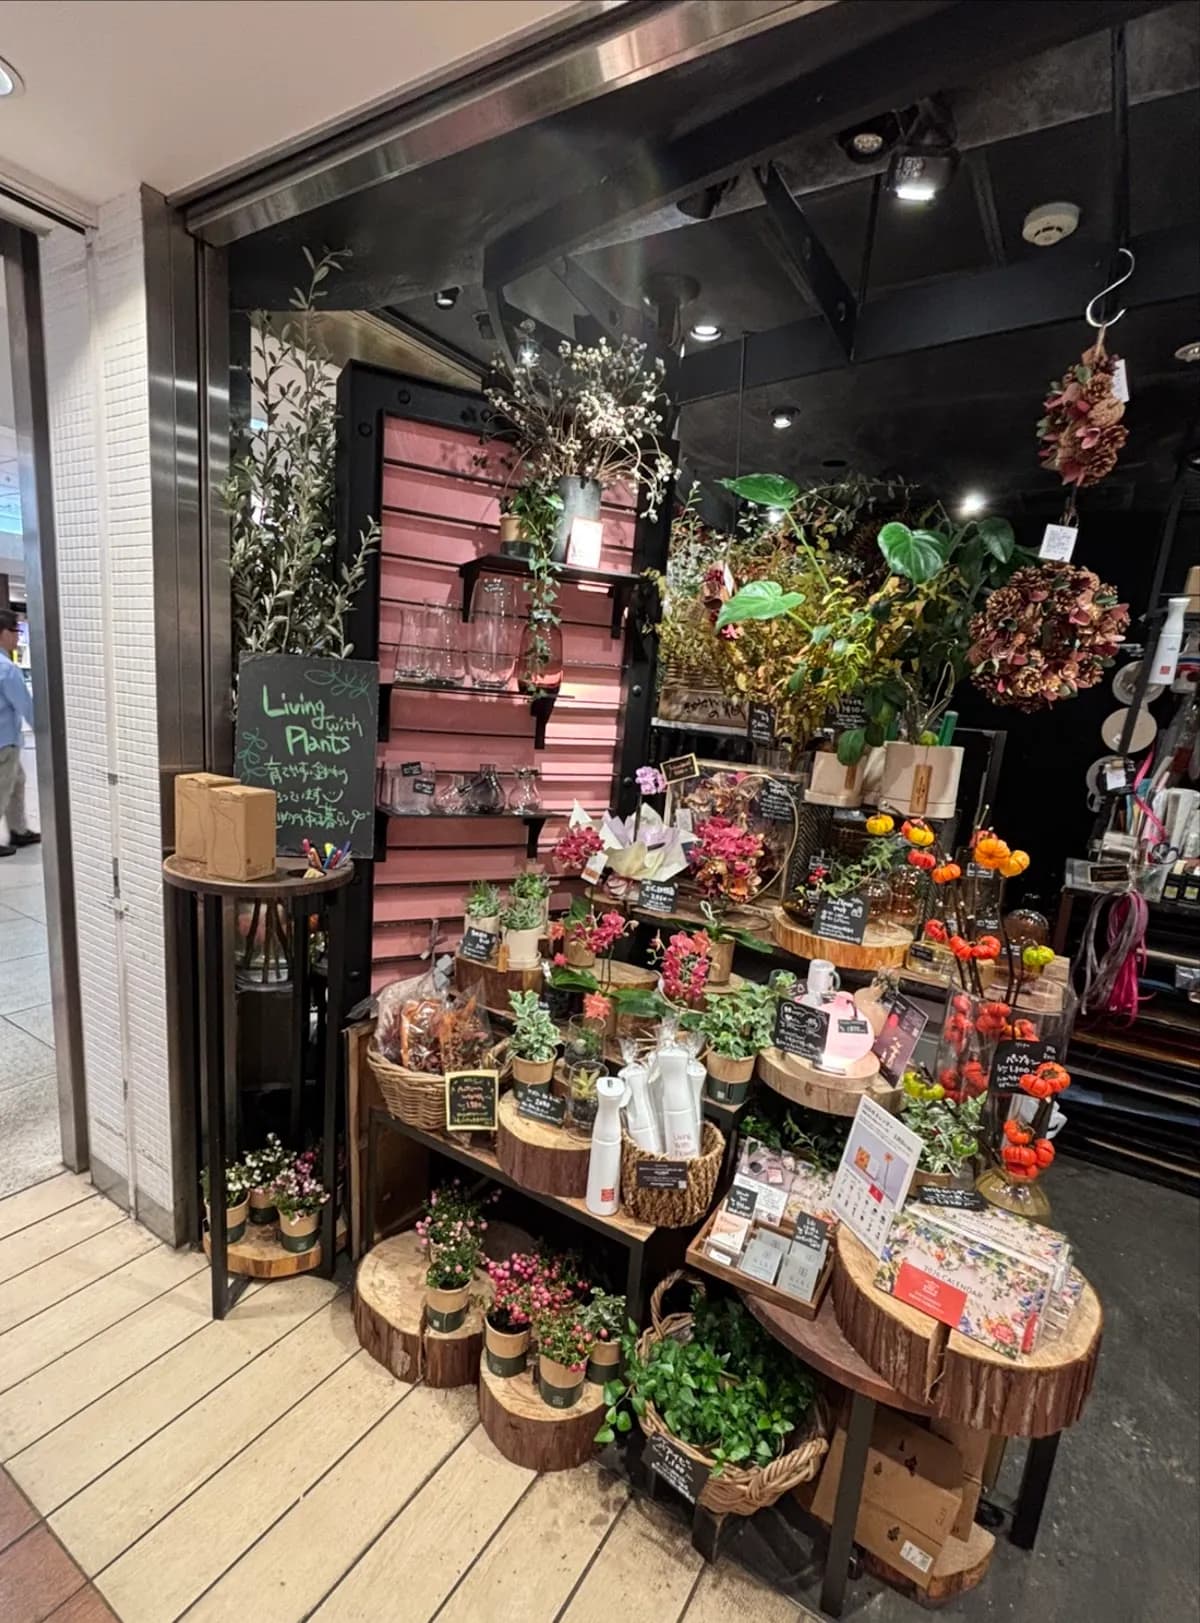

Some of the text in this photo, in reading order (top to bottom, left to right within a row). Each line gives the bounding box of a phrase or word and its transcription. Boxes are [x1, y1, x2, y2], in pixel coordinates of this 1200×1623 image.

[262, 685, 331, 730] Living
[326, 713, 363, 737] with
[285, 725, 351, 756] Plants
[277, 787, 322, 805] ろっています
[942, 1273, 984, 1298] CALENDAR
